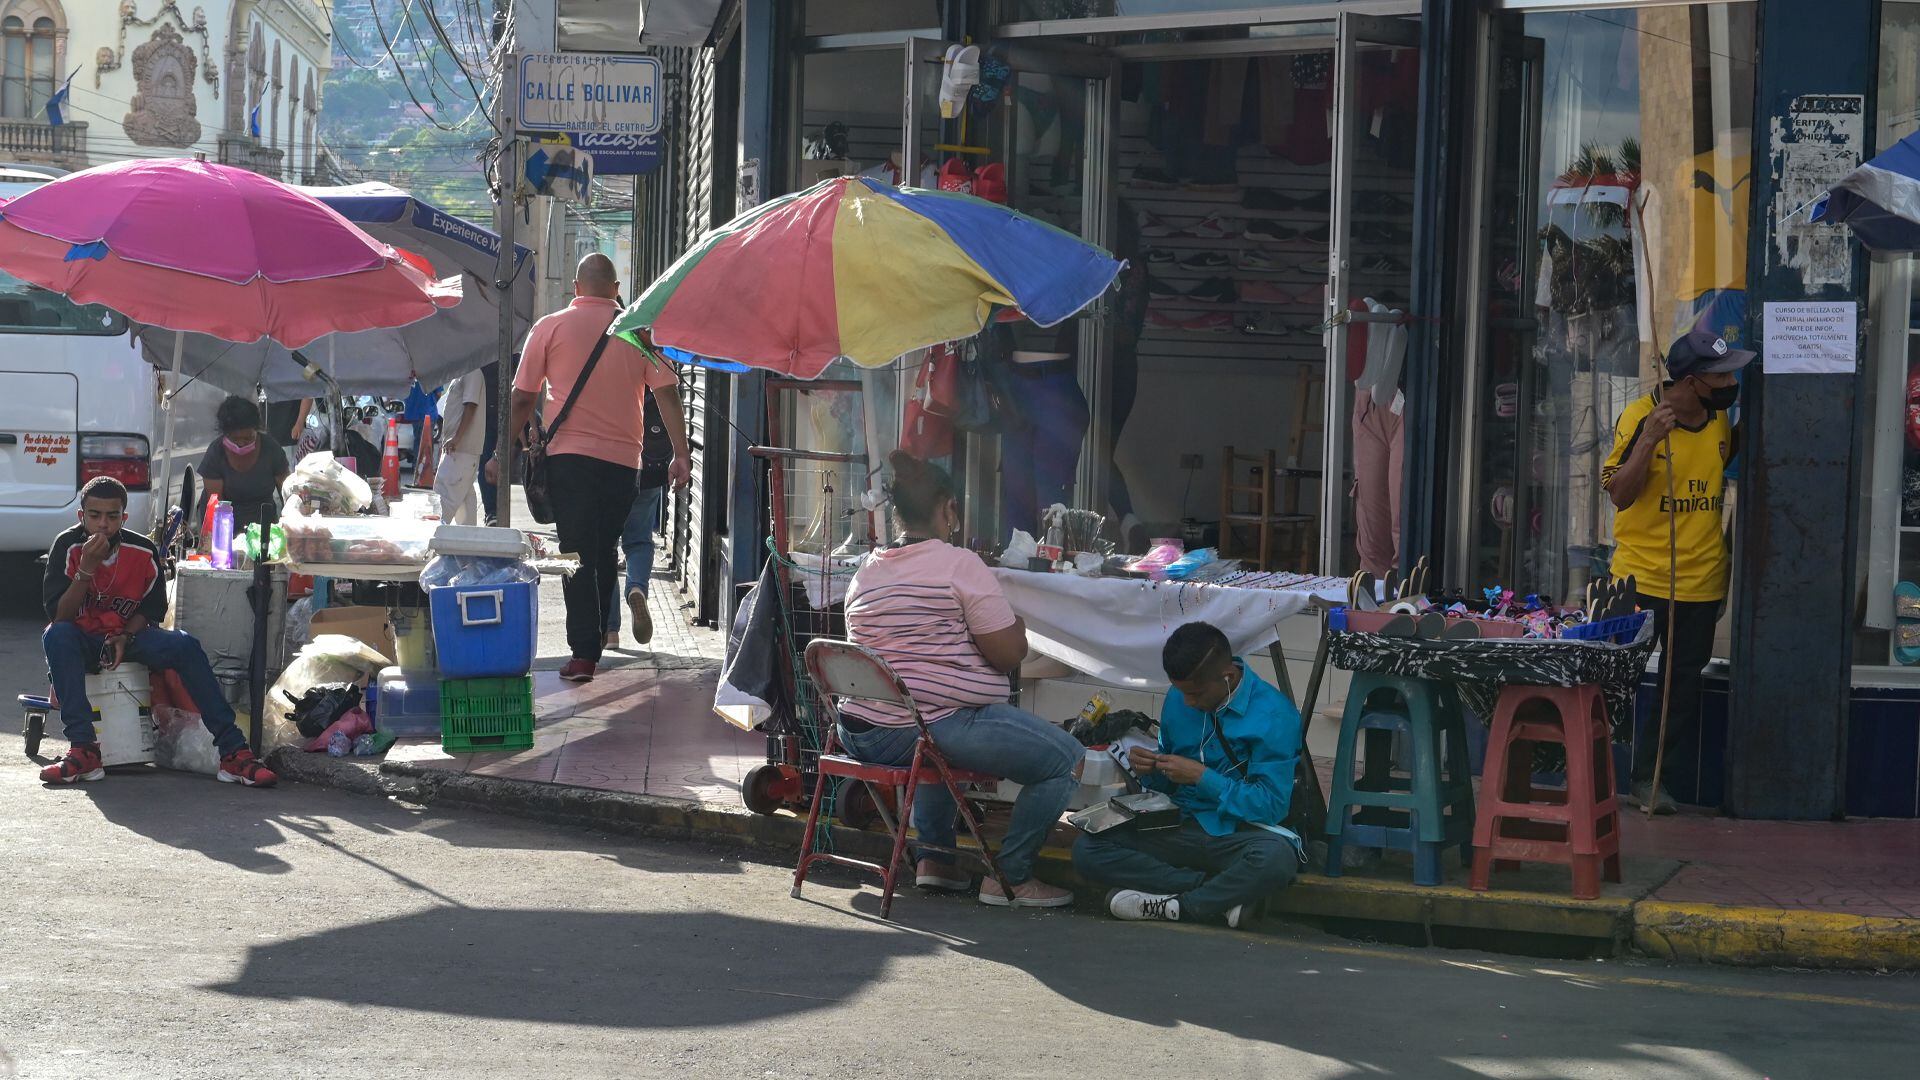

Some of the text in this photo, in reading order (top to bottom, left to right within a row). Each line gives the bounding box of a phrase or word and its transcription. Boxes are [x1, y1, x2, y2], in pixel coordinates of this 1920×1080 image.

[526, 82, 652, 103] CALLE BOLIVAR
[566, 121, 645, 132] BARRIO EL CENTRO
[432, 213, 488, 247] Experience
[1688, 479, 1709, 494] Fly
